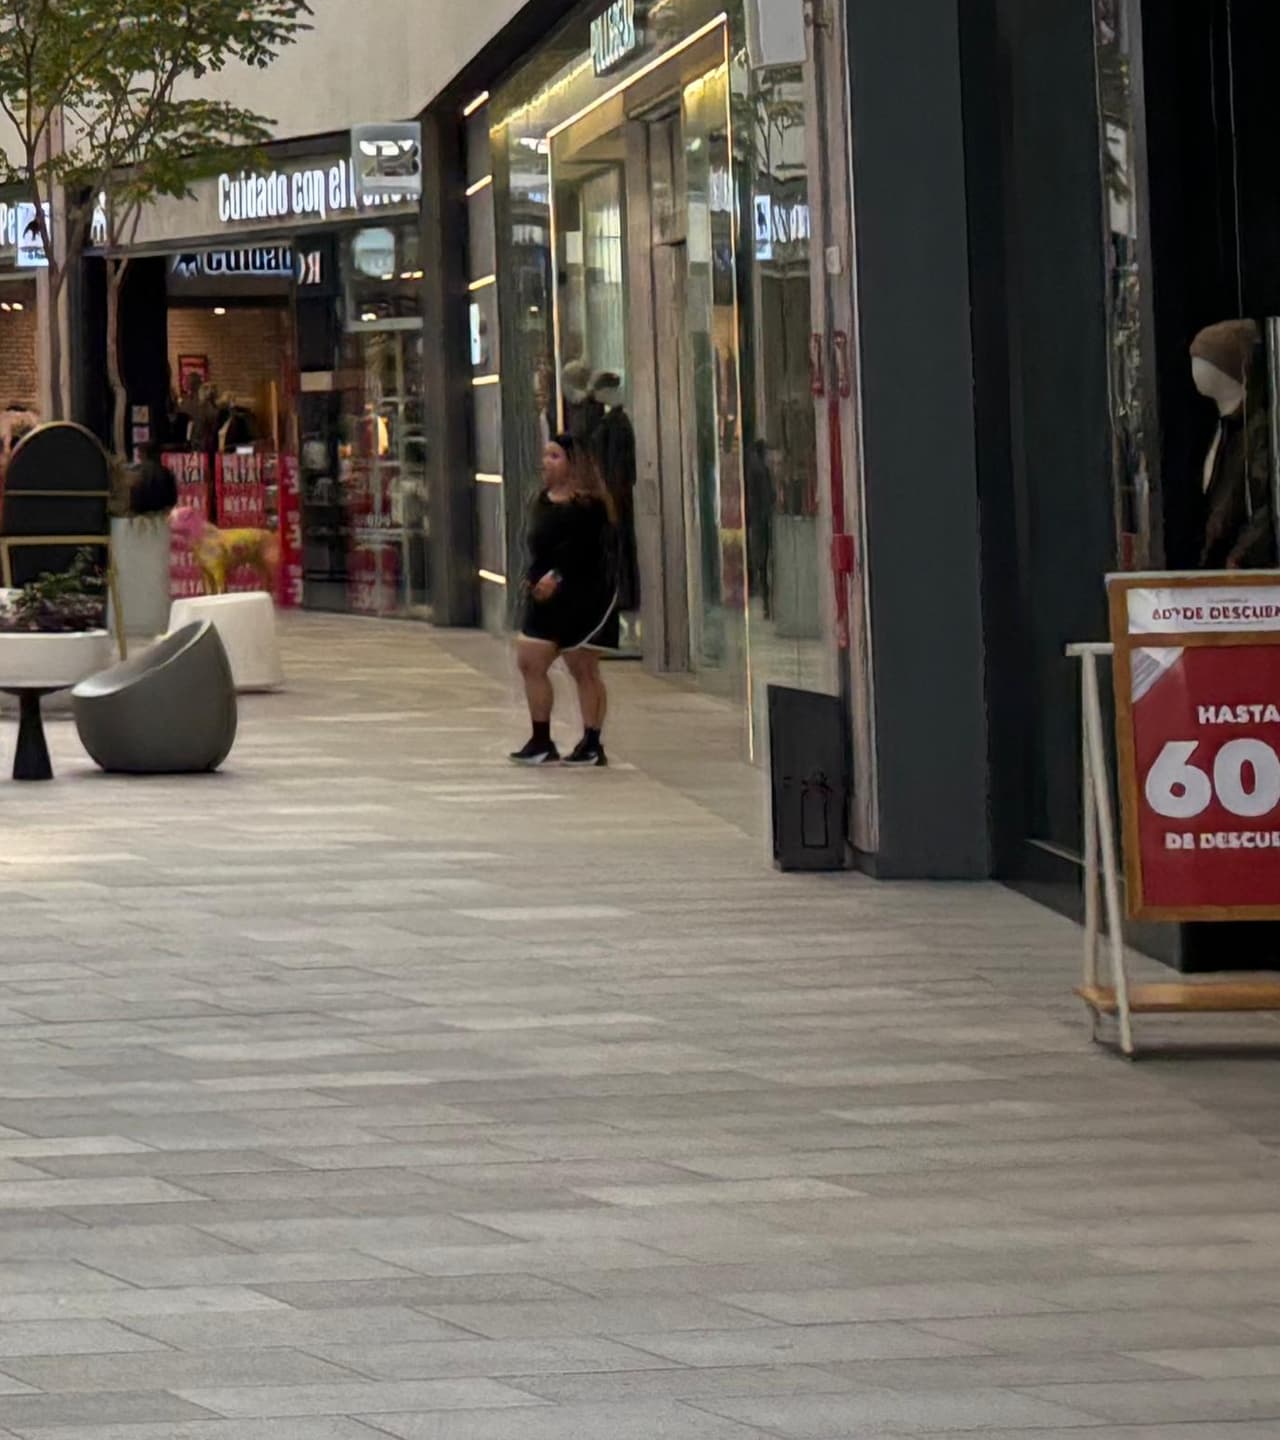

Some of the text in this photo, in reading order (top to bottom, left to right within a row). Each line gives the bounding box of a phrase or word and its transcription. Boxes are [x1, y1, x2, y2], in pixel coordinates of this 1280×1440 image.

[218, 170, 288, 222] Cuidado
[291, 169, 327, 220] con
[328, 158, 347, 210] el
[1197, 703, 1280, 725] HASTA
[1145, 737, 1280, 819] 60
[1164, 830, 1280, 850] DE DESCUE
